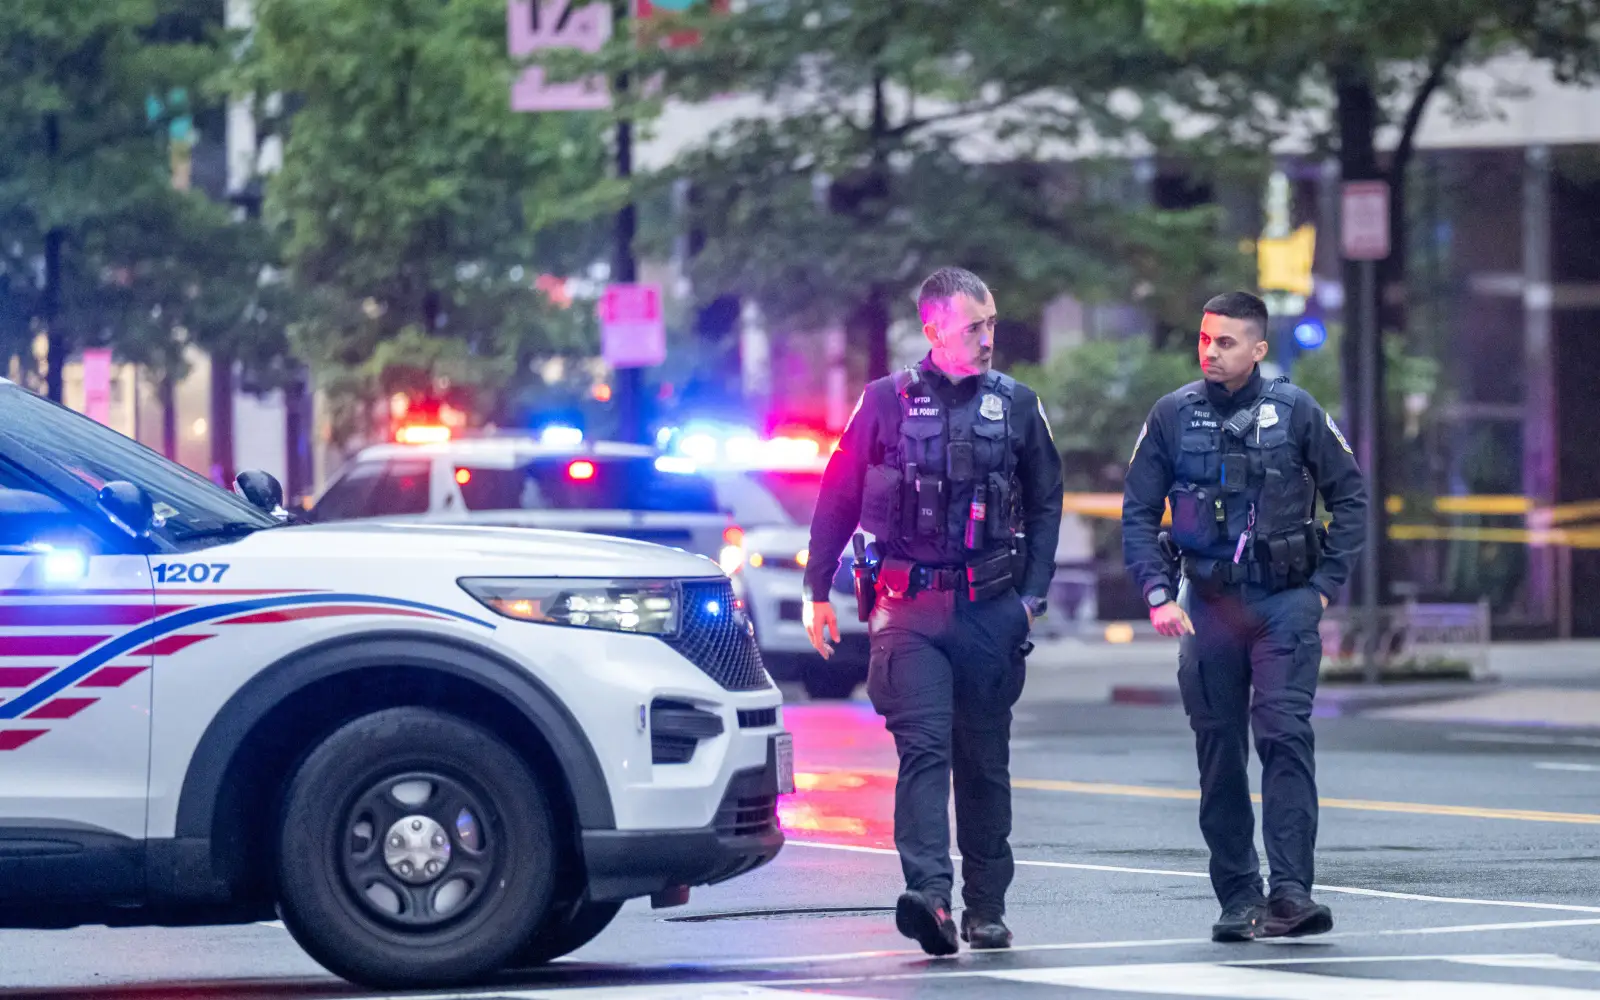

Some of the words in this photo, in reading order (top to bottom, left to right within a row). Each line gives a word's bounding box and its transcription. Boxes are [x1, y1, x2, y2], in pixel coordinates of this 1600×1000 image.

[1194, 410, 1210, 418] POLICE
[921, 507, 933, 516] TQ
[152, 563, 231, 583] 1207
